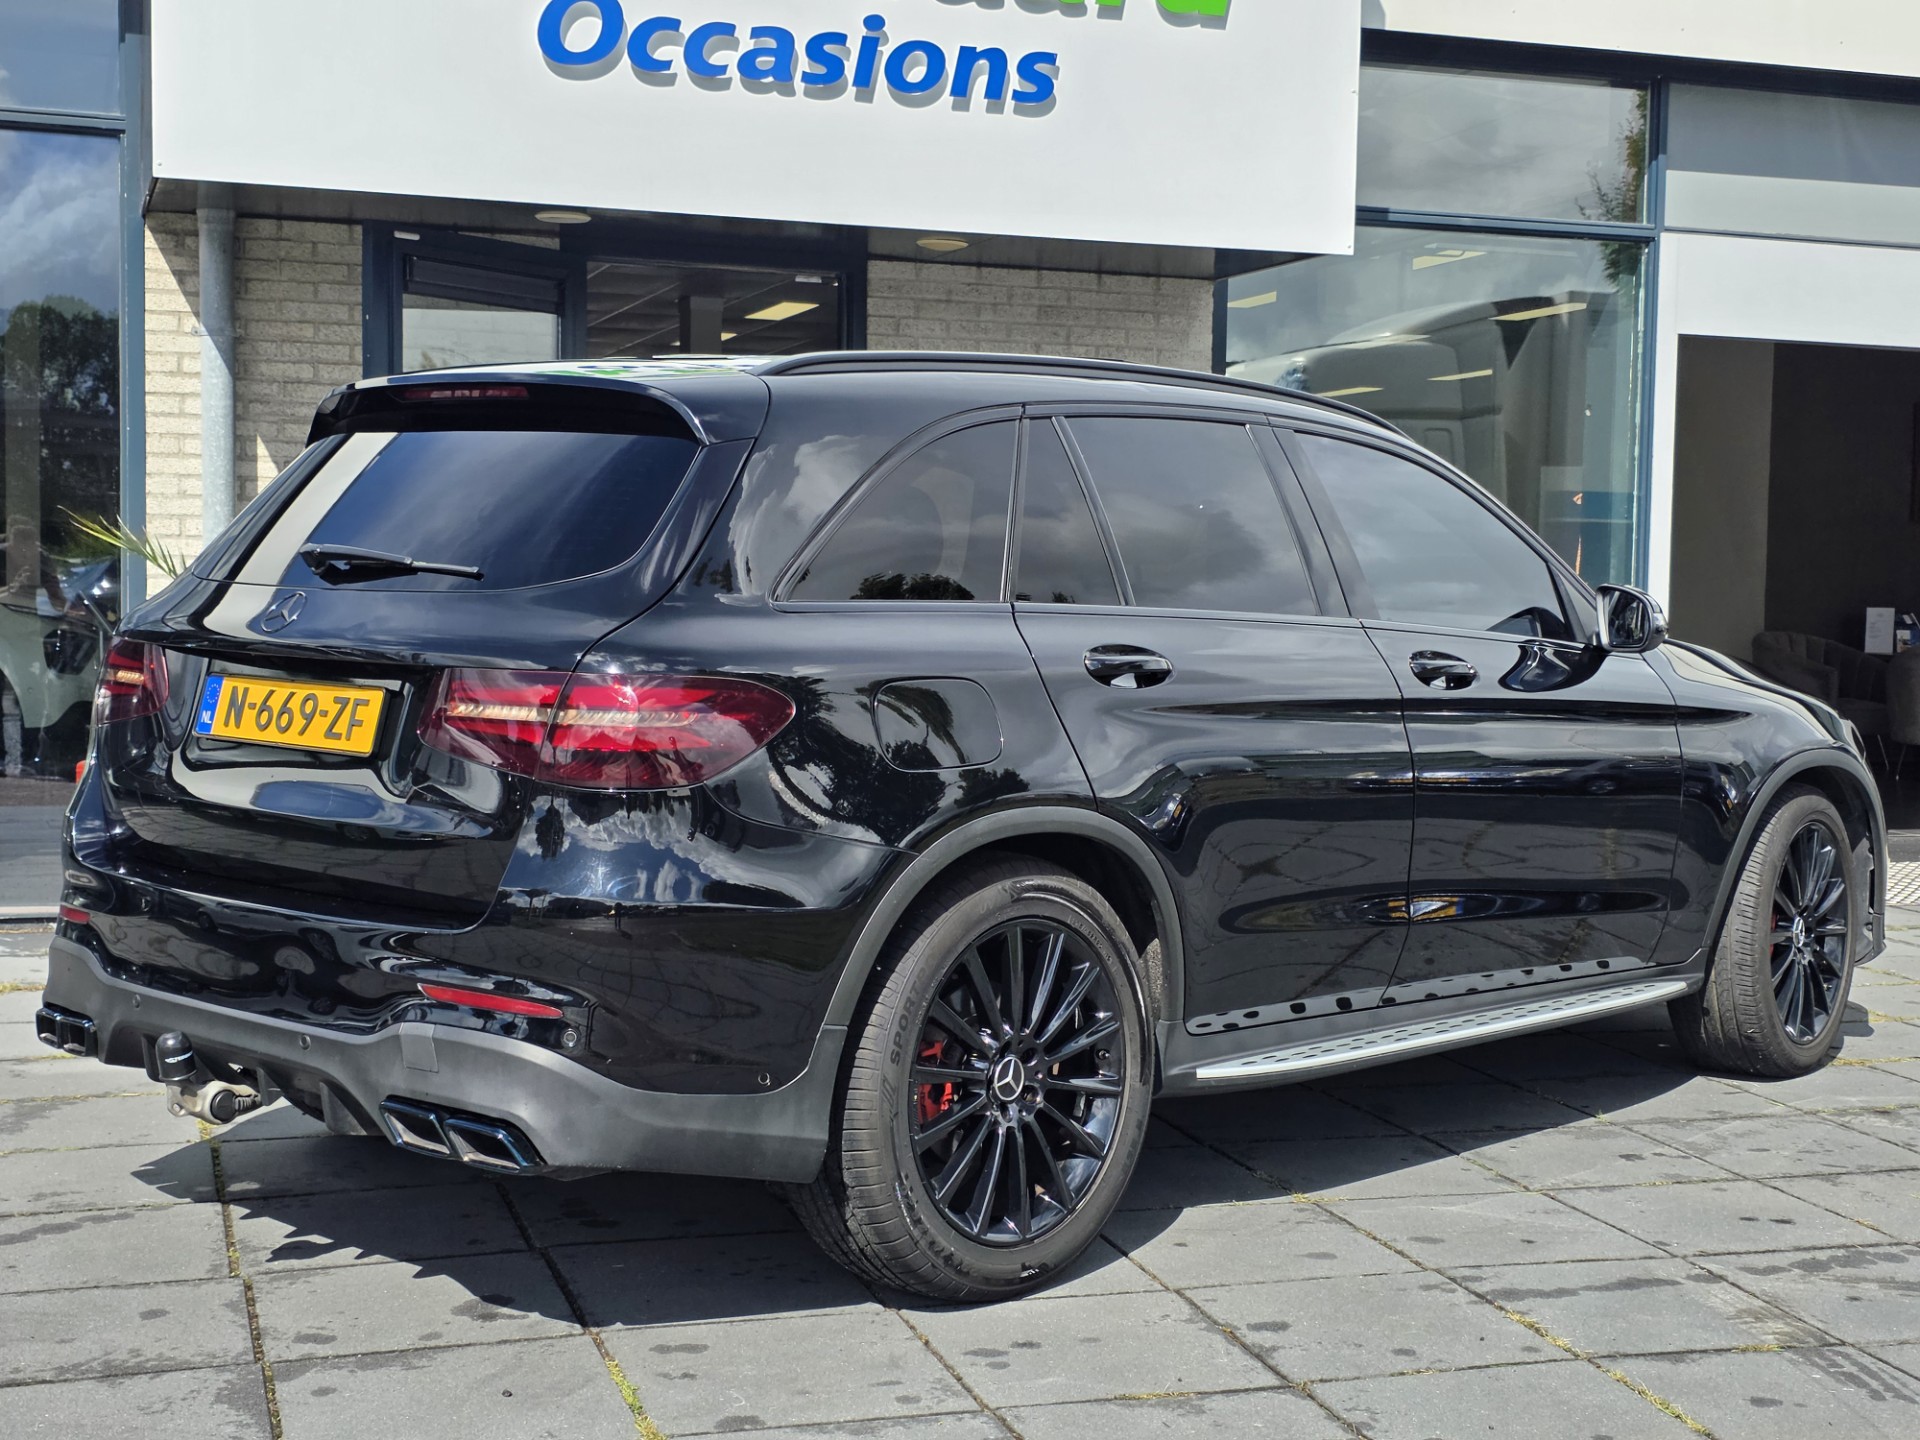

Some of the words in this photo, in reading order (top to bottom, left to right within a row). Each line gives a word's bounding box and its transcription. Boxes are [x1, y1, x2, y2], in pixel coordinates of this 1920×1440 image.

[537, 0, 1057, 104] Occasions
[201, 710, 213, 724] NL
[223, 686, 370, 741] N-669-ZF
